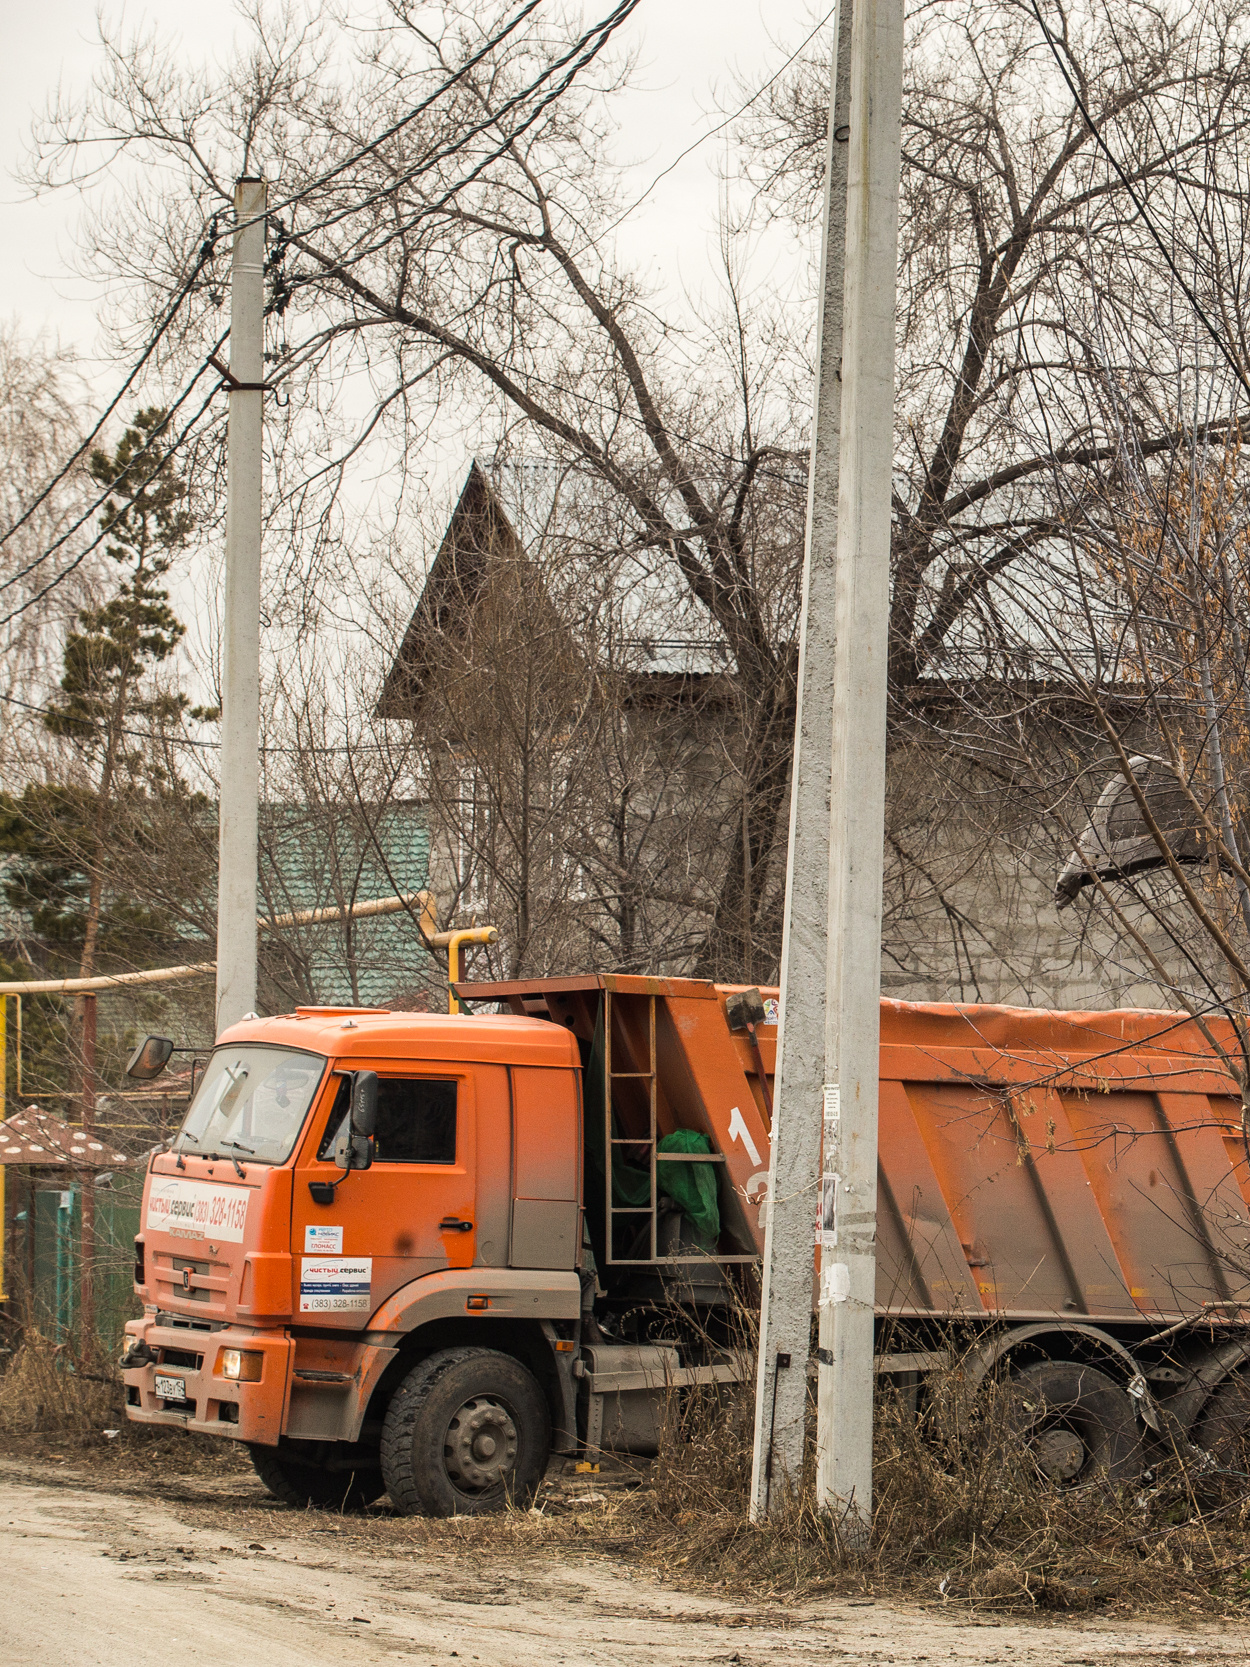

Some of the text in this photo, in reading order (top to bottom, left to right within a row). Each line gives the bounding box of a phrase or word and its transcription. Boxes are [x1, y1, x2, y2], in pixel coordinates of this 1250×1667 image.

[209, 1195, 247, 1230] 328-1158
[169, 1227, 205, 1241] KAMAZ
[339, 1267, 367, 1275] сервис
[311, 1298, 368, 1310] (383) 328-1158
